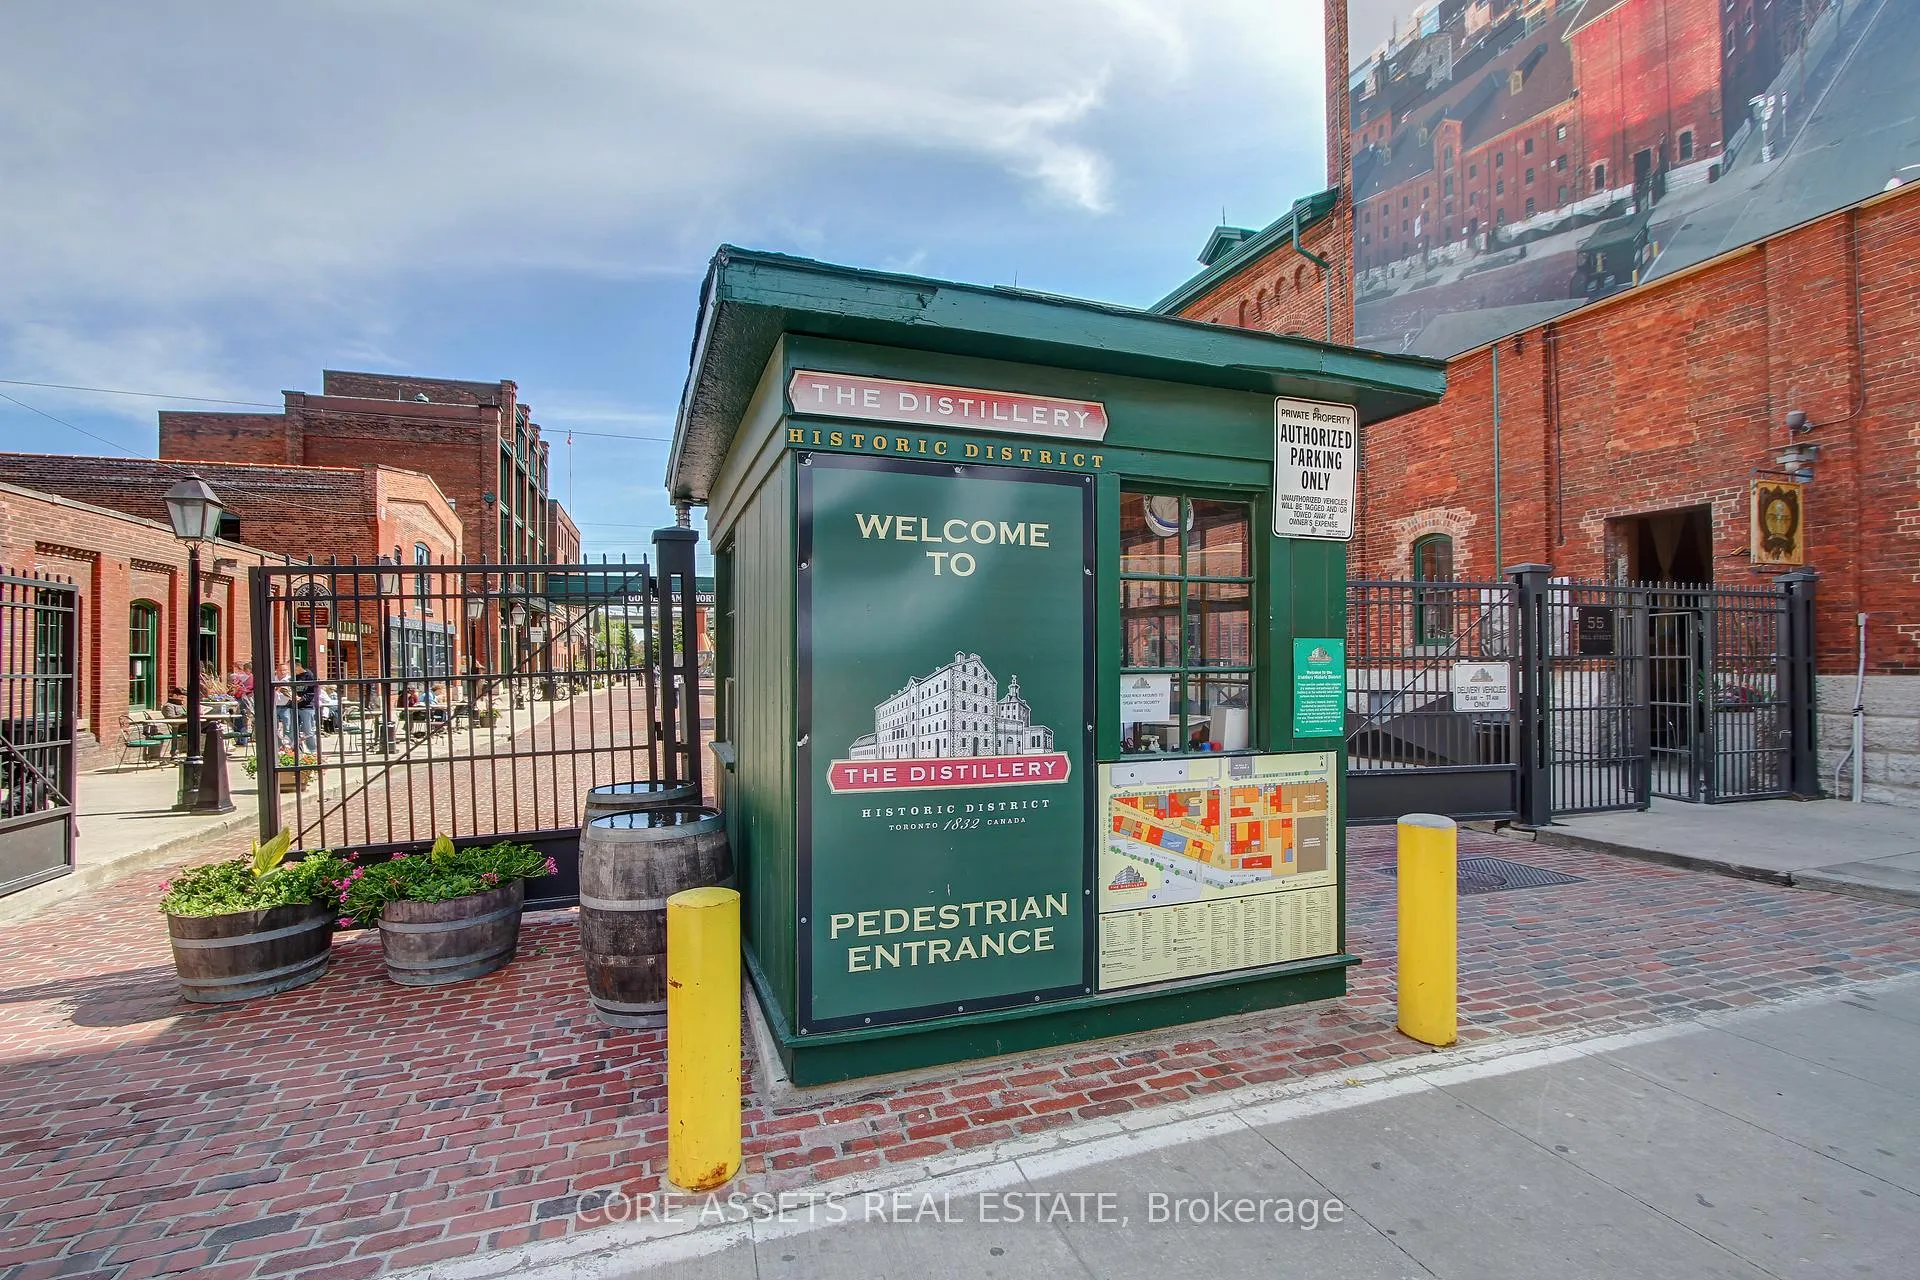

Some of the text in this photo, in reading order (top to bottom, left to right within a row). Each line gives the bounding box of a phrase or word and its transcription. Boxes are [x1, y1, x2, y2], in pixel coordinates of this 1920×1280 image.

[811, 383, 1091, 429] THE DISTILLERY
[1281, 408, 1351, 425] PRIVATE PROPERTY
[1280, 423, 1352, 449] AUTHORIZED
[788, 428, 1104, 468] HISTORIC DISTRICT
[1290, 447, 1342, 470] PARKING
[1301, 470, 1331, 491] ONLY
[1281, 494, 1348, 506] UNAUTHORIZED VEHICLES
[1281, 502, 1294, 510] WILL
[1295, 503, 1303, 511] BE
[1304, 504, 1325, 512] TAGGED
[1288, 518, 1339, 529] OWNER'S EXPENSE
[1294, 511, 1312, 519] TOWED
[855, 513, 1050, 548] WELCOME
[926, 551, 977, 578] TO
[1587, 616, 1605, 629] 55
[1457, 685, 1507, 694] DELIVERY VEHICLES
[845, 761, 1057, 784] THE DISTILLERY
[862, 799, 1051, 818] HISTORIC DISTRICT
[889, 816, 1026, 831] TORONTO 1832 CANADA
[830, 892, 1069, 940] PEDESTRIAN
[848, 926, 1055, 973] ENTRANCE
